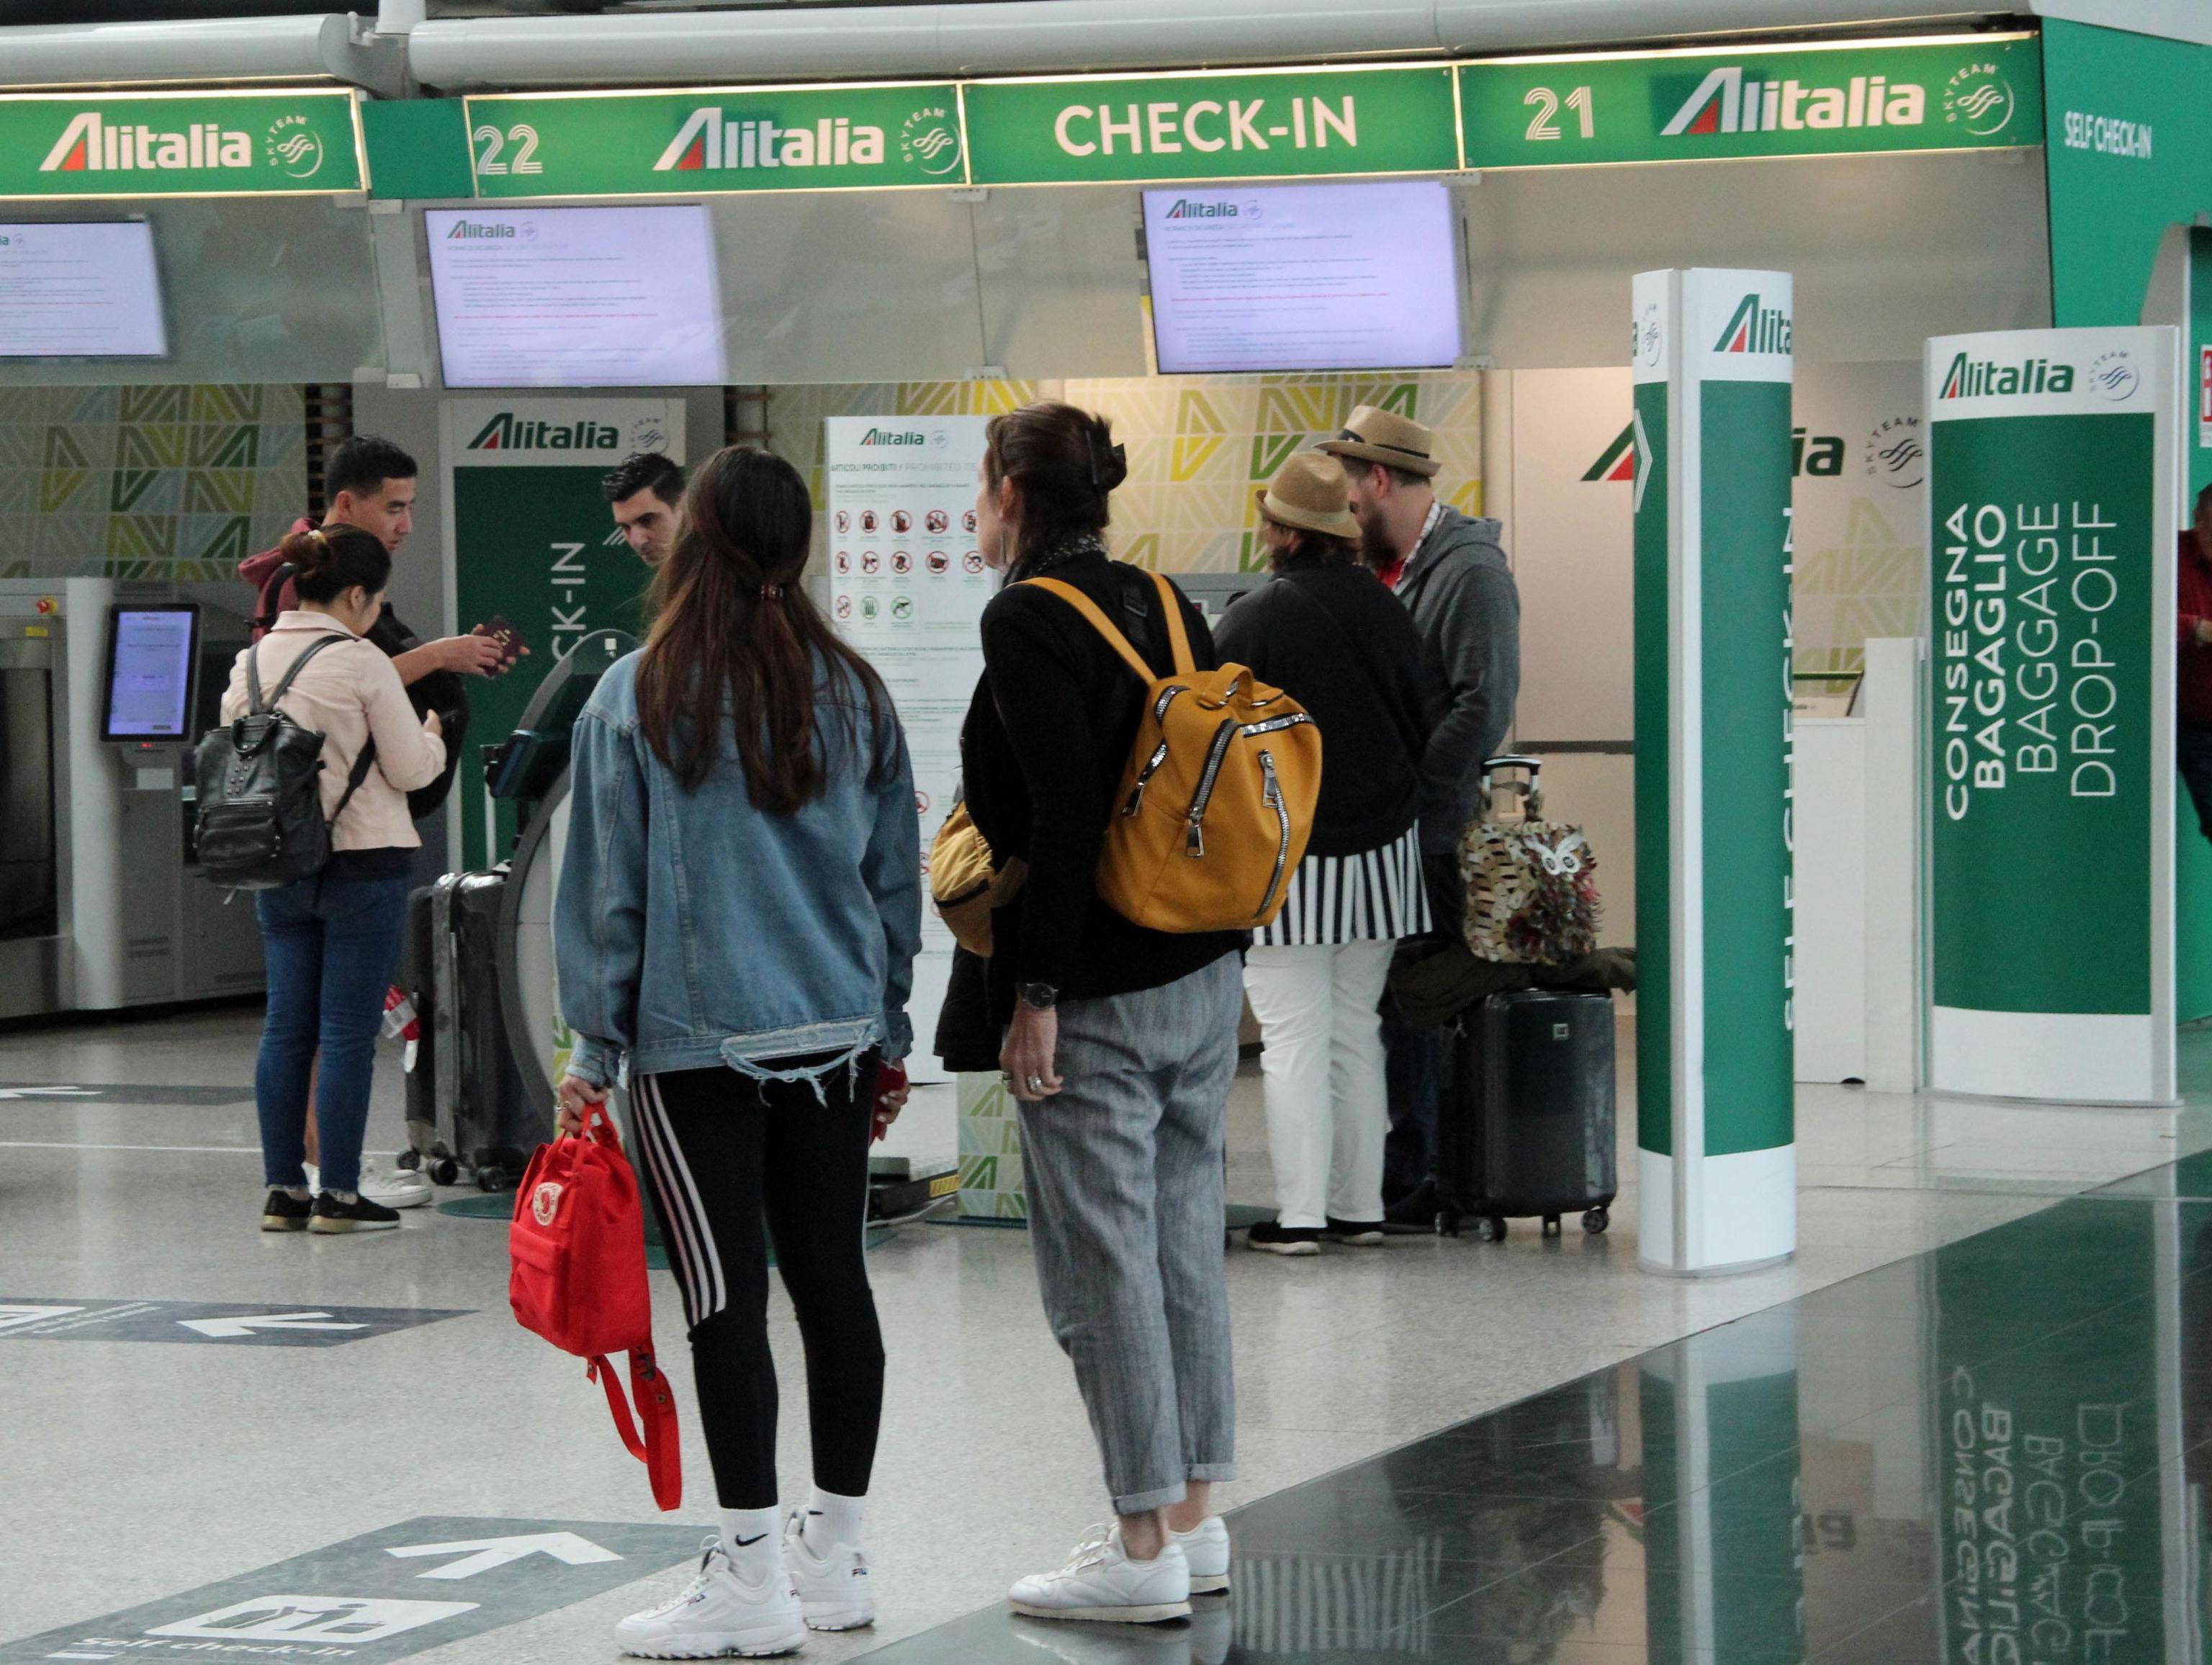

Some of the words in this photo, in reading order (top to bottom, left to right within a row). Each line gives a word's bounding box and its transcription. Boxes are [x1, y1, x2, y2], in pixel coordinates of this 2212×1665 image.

[1053, 96, 1358, 156] CHECK-IN
[1523, 85, 1595, 142] 21
[1660, 66, 1925, 136] Alitalia
[39, 112, 251, 171] Alitalia
[472, 124, 544, 175] 22
[652, 107, 885, 171] Alitalia
[2064, 111, 2094, 149] SELF
[2094, 116, 2152, 159] CHECK-IN
[446, 220, 516, 239] Alitalia
[1164, 199, 1238, 219] Alitalia
[1938, 352, 2076, 400] Alitalia
[467, 412, 620, 450] Alitalia
[860, 428, 925, 446] Alitalia
[1945, 503, 1969, 821] CONSEGNA
[1974, 504, 2007, 788] BAGAGLIO
[2016, 502, 2059, 773] BAGGAGE
[2070, 501, 2118, 797] DROP-OFF
[170, 1641, 359, 1657] check-in
